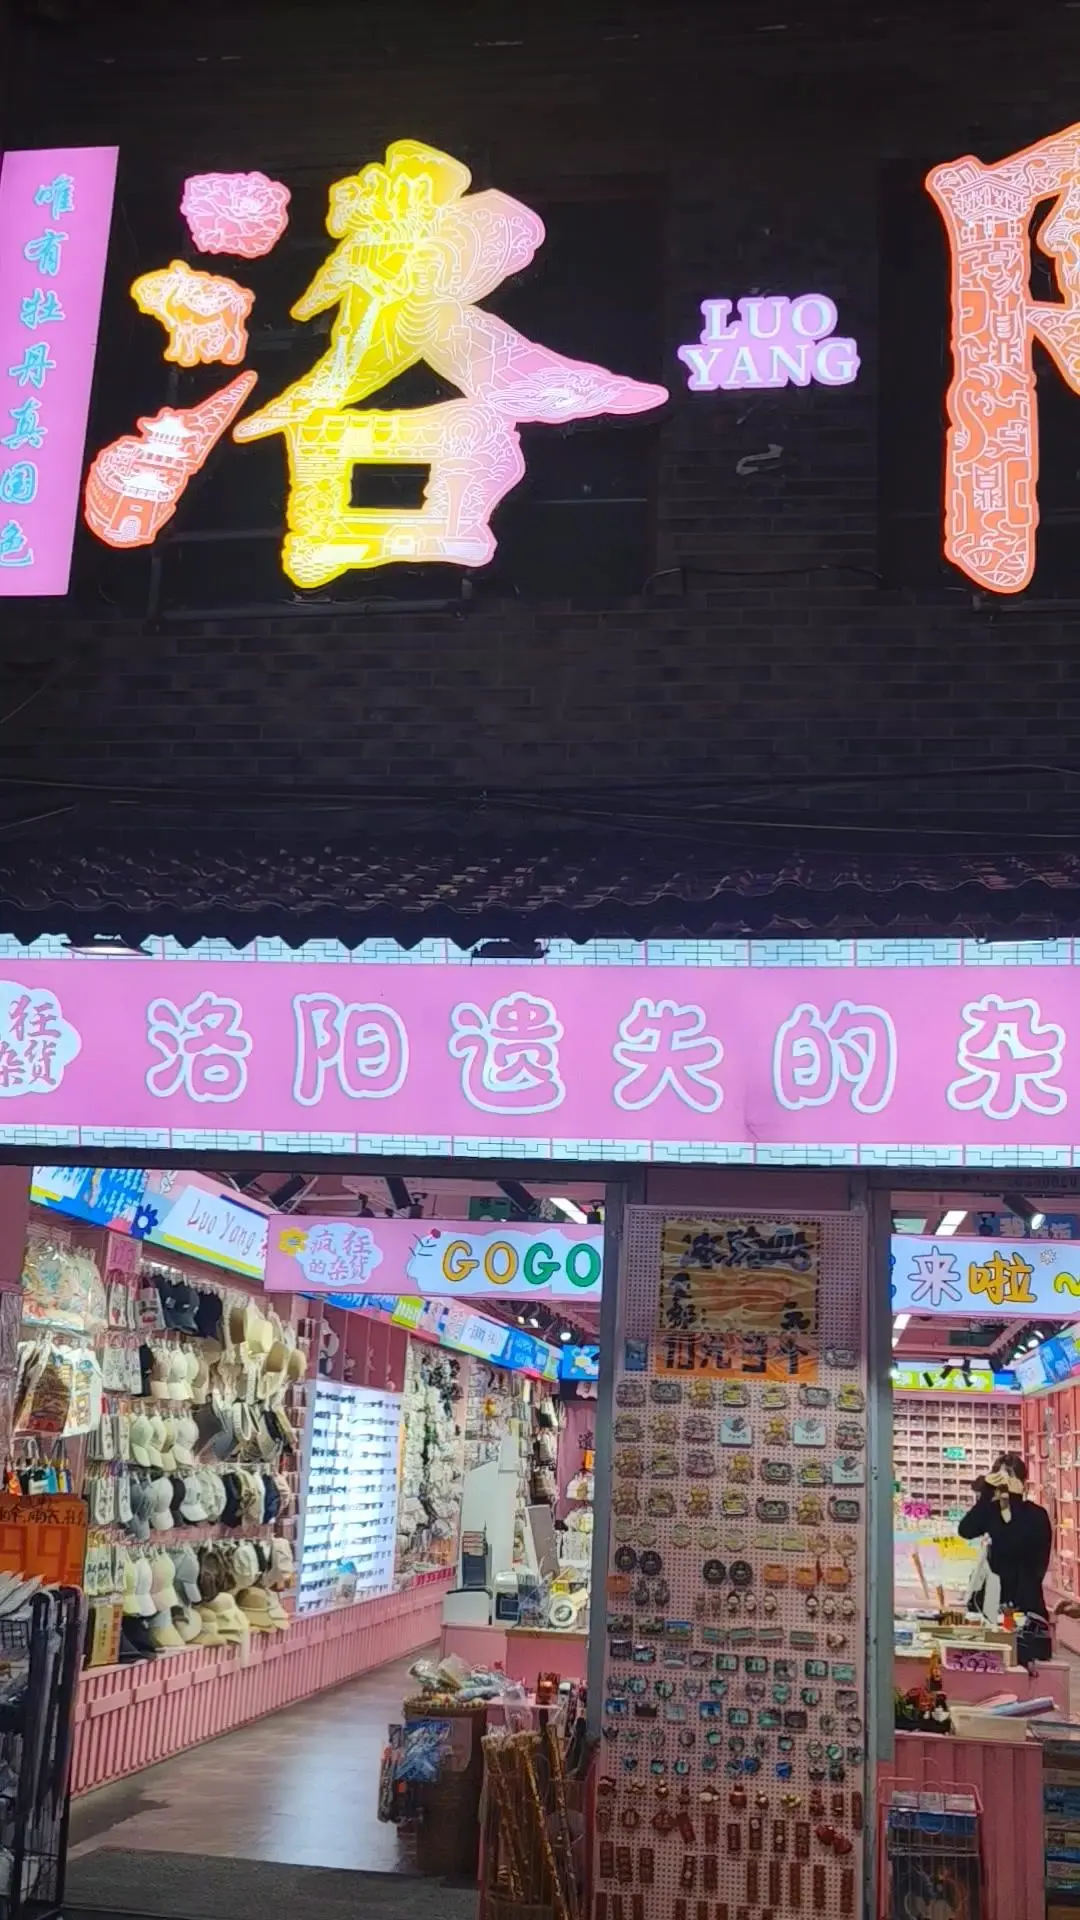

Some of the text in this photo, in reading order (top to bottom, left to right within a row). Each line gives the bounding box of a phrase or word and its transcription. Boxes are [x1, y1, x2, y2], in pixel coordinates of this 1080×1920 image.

[700, 295, 838, 342] LUO
[678, 340, 861, 391] YANG
[146, 990, 1068, 1120] 洛阳遗失的杂
[441, 1240, 602, 1288] GOGO
